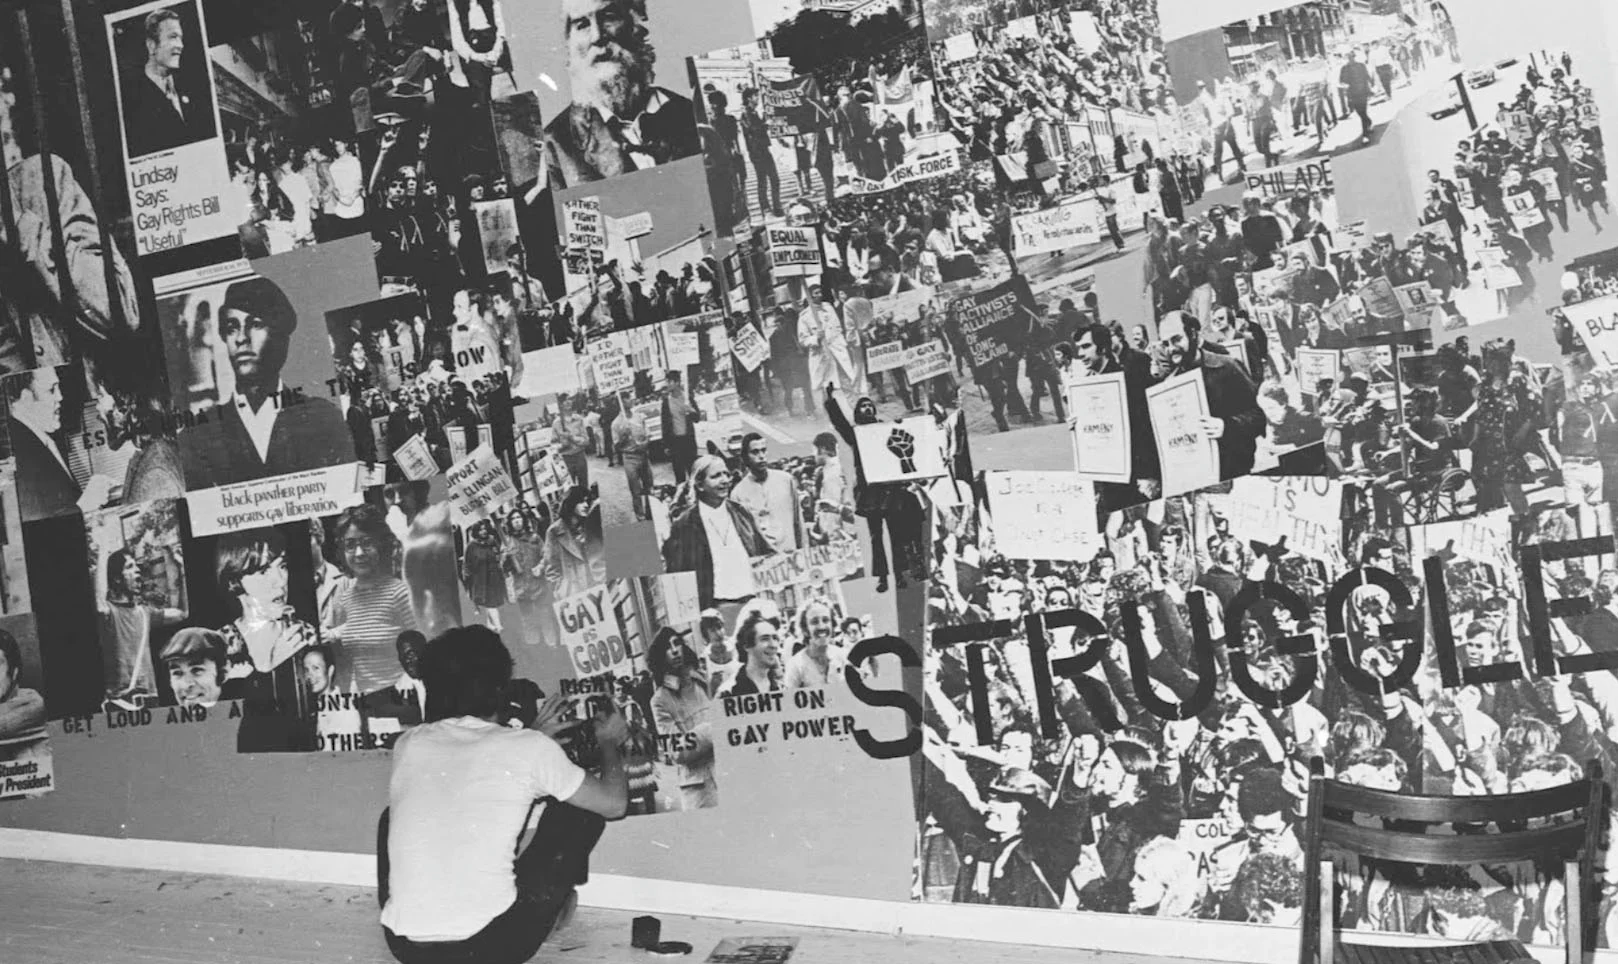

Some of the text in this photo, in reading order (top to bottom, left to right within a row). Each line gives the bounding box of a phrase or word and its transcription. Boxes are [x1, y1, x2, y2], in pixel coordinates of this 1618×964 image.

[919, 155, 954, 175] FORCE
[131, 165, 178, 188] Lindsay
[135, 189, 170, 208] Says:
[137, 195, 220, 231] Gay Rights Bill
[571, 211, 598, 223] FIGHT
[575, 223, 597, 233] THAN
[770, 230, 809, 243] EQUAL
[569, 233, 604, 245] SWITCH
[955, 295, 977, 313] GAY
[960, 291, 1018, 324] ACTIVISTS
[961, 305, 1015, 335] ALLIANCE
[734, 330, 758, 356] STOP
[965, 333, 978, 345] OF
[969, 337, 996, 355] LONG
[600, 359, 622, 370] FIGHT
[974, 343, 1009, 367] ISLAND
[599, 376, 630, 390] SWITCH
[603, 369, 623, 378] THAN
[446, 459, 479, 489] UPPORT
[560, 590, 605, 634] GAY
[582, 628, 599, 643] IS
[573, 635, 625, 674] GOOD
[845, 535, 1618, 759] STRUGGLE
[723, 689, 826, 717] RIGHT ON
[63, 716, 94, 735] GET
[106, 710, 152, 729] LOUD
[166, 705, 208, 725] AND
[727, 714, 855, 747] GAY POWER
[5, 774, 51, 792] President
[1195, 822, 1229, 839] COL
